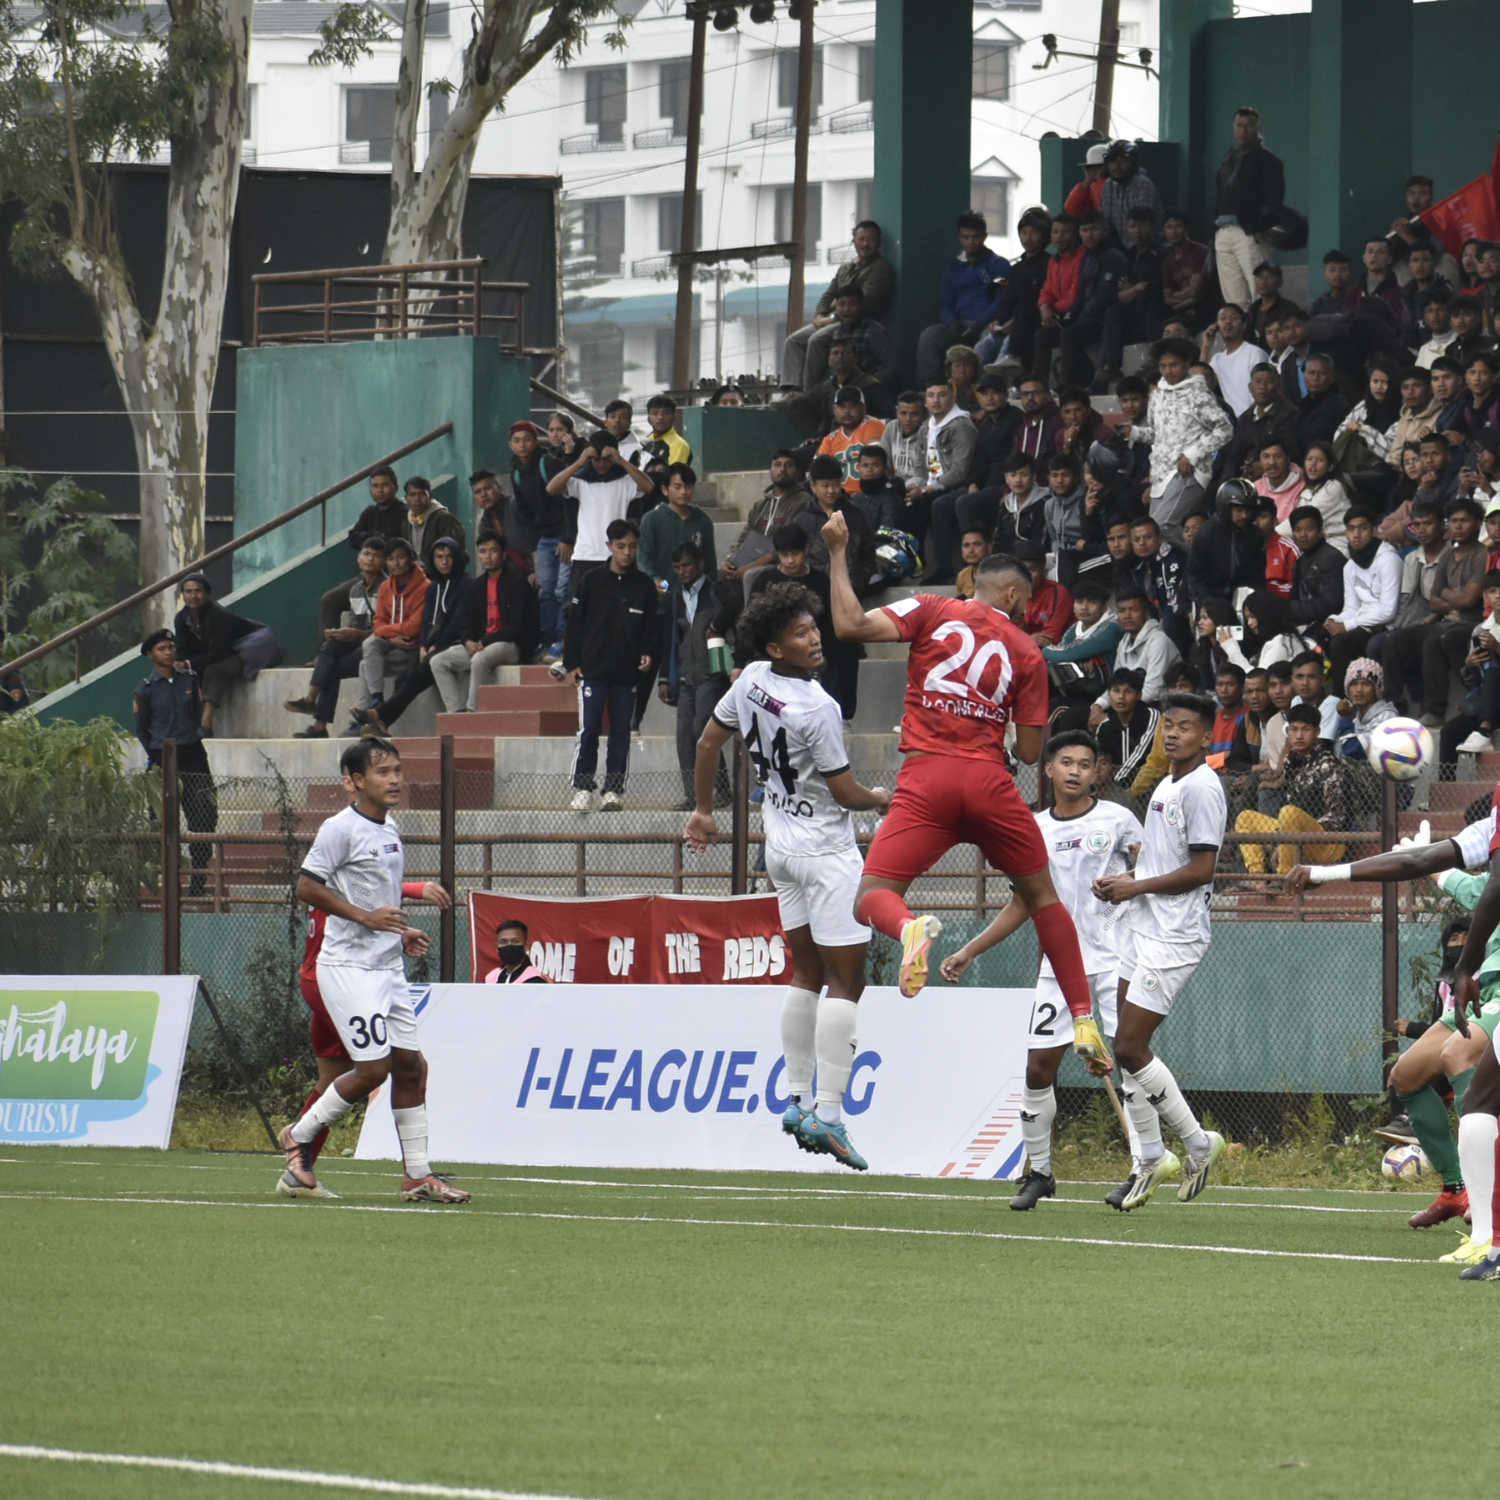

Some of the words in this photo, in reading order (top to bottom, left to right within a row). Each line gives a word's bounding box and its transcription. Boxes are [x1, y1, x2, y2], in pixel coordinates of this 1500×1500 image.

[923, 620, 1013, 705] 20
[526, 940, 577, 983] OME
[607, 936, 635, 977] OF
[665, 932, 701, 974] THE
[722, 934, 786, 981] REDS
[0, 1000, 138, 1091] halaya
[348, 1013, 388, 1049] 30
